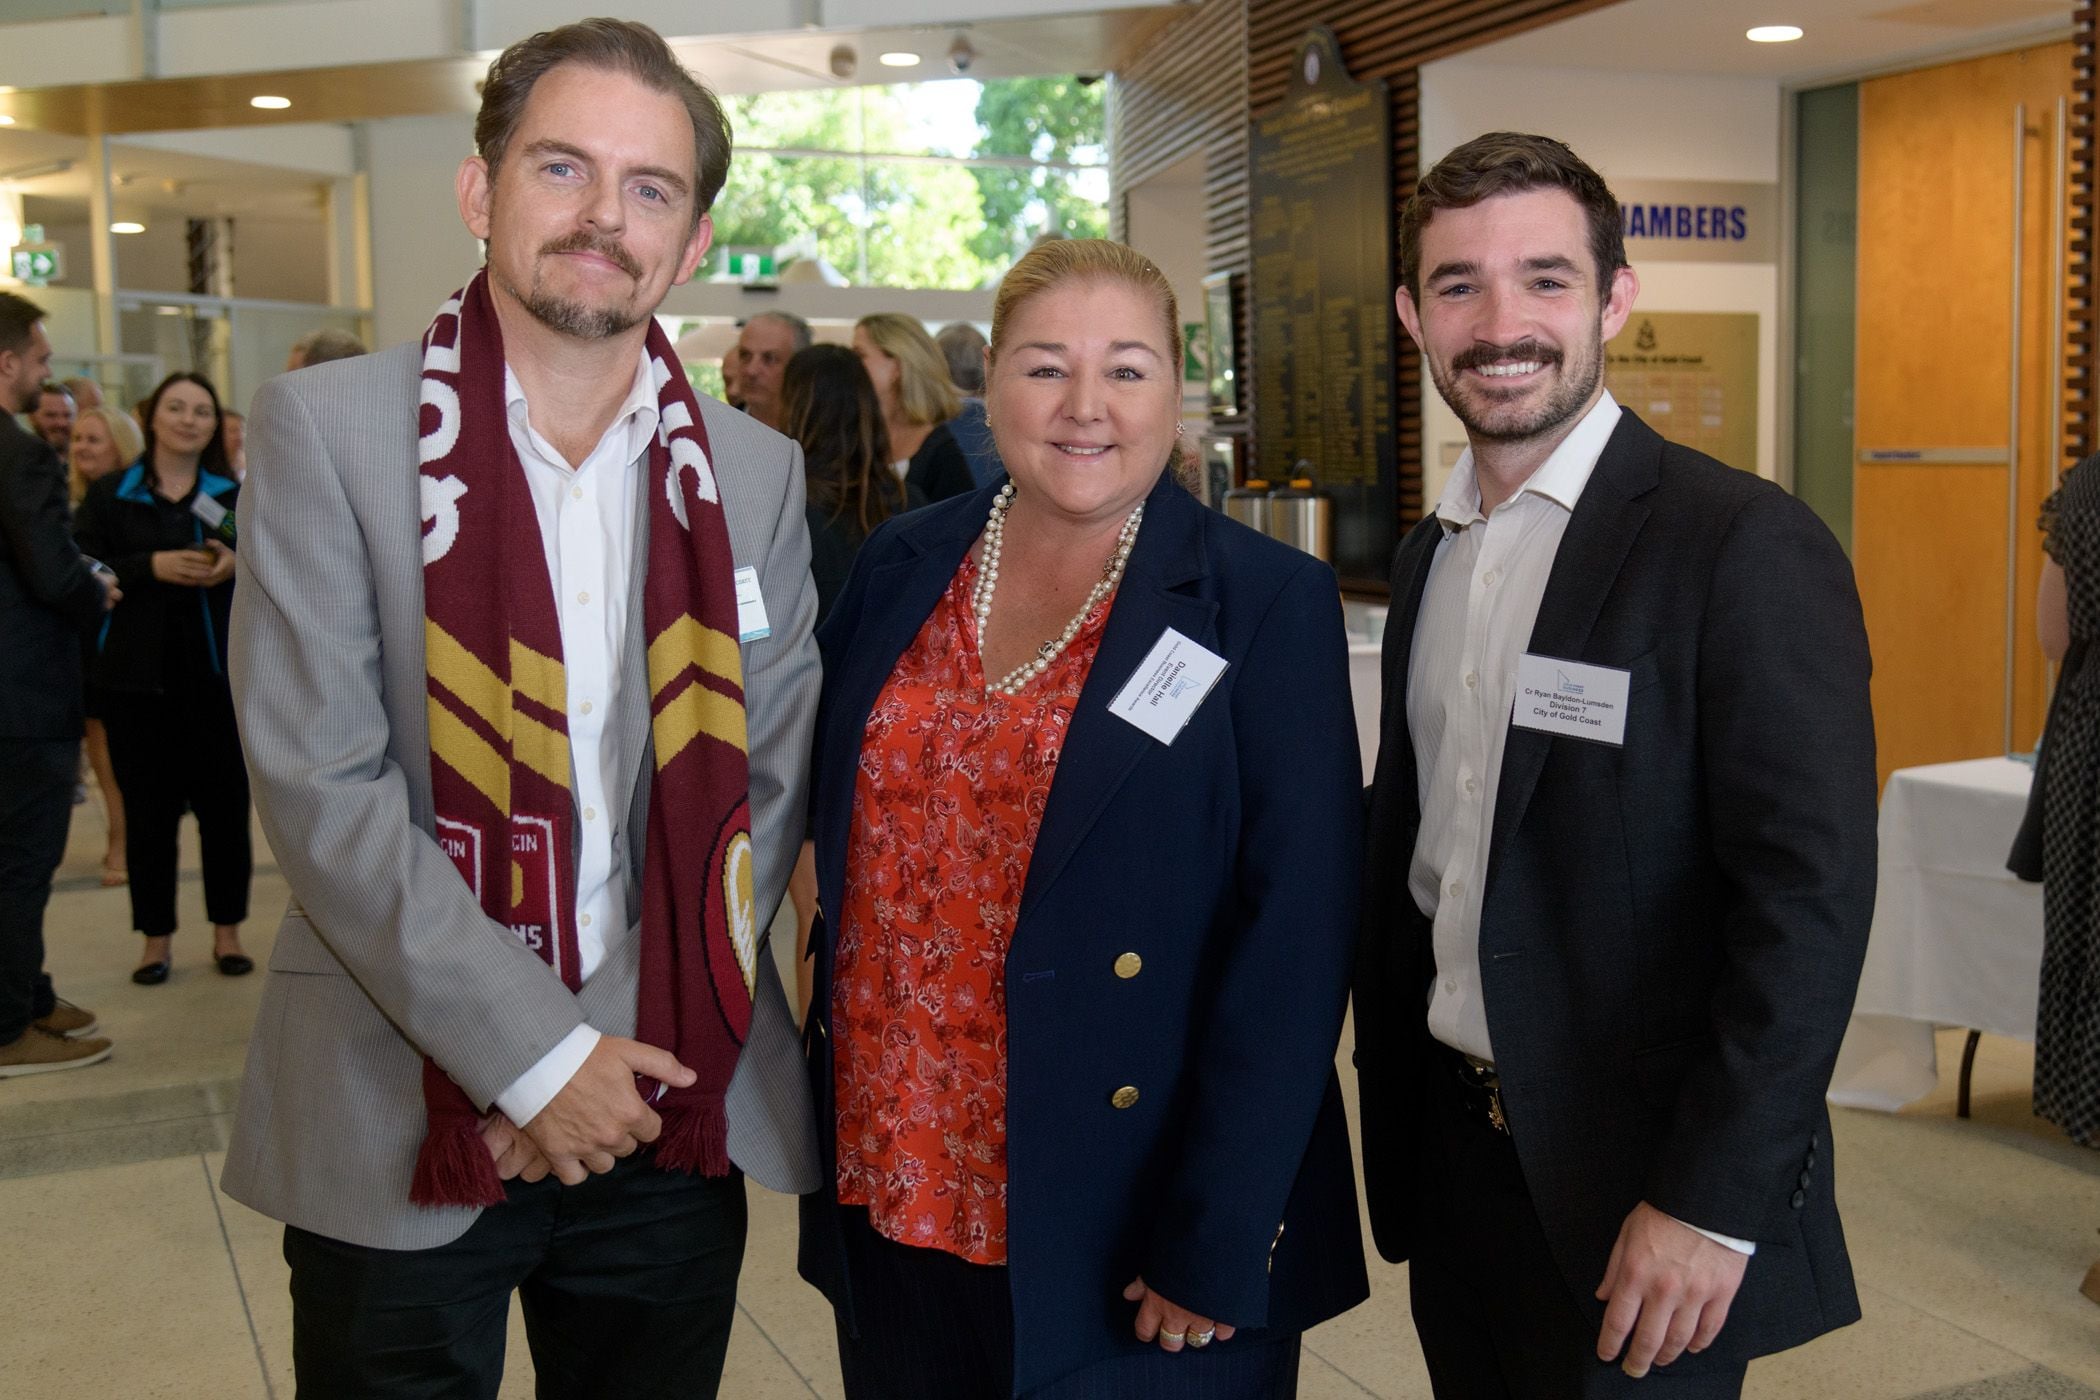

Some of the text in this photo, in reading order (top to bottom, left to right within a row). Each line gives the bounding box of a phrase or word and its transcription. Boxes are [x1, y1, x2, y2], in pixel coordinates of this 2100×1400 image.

[1148, 662, 1173, 695] Event Director
[1161, 661, 1186, 690] Danielle
[1150, 691, 1165, 706] Hall
[1534, 690, 1552, 698] Ryan
[1553, 693, 1614, 709] Bayldon-Lumsden
[1549, 701, 1580, 713] Division
[1533, 708, 1548, 718] City
[1559, 713, 1577, 722] Gold
[1579, 715, 1602, 726] Coast
